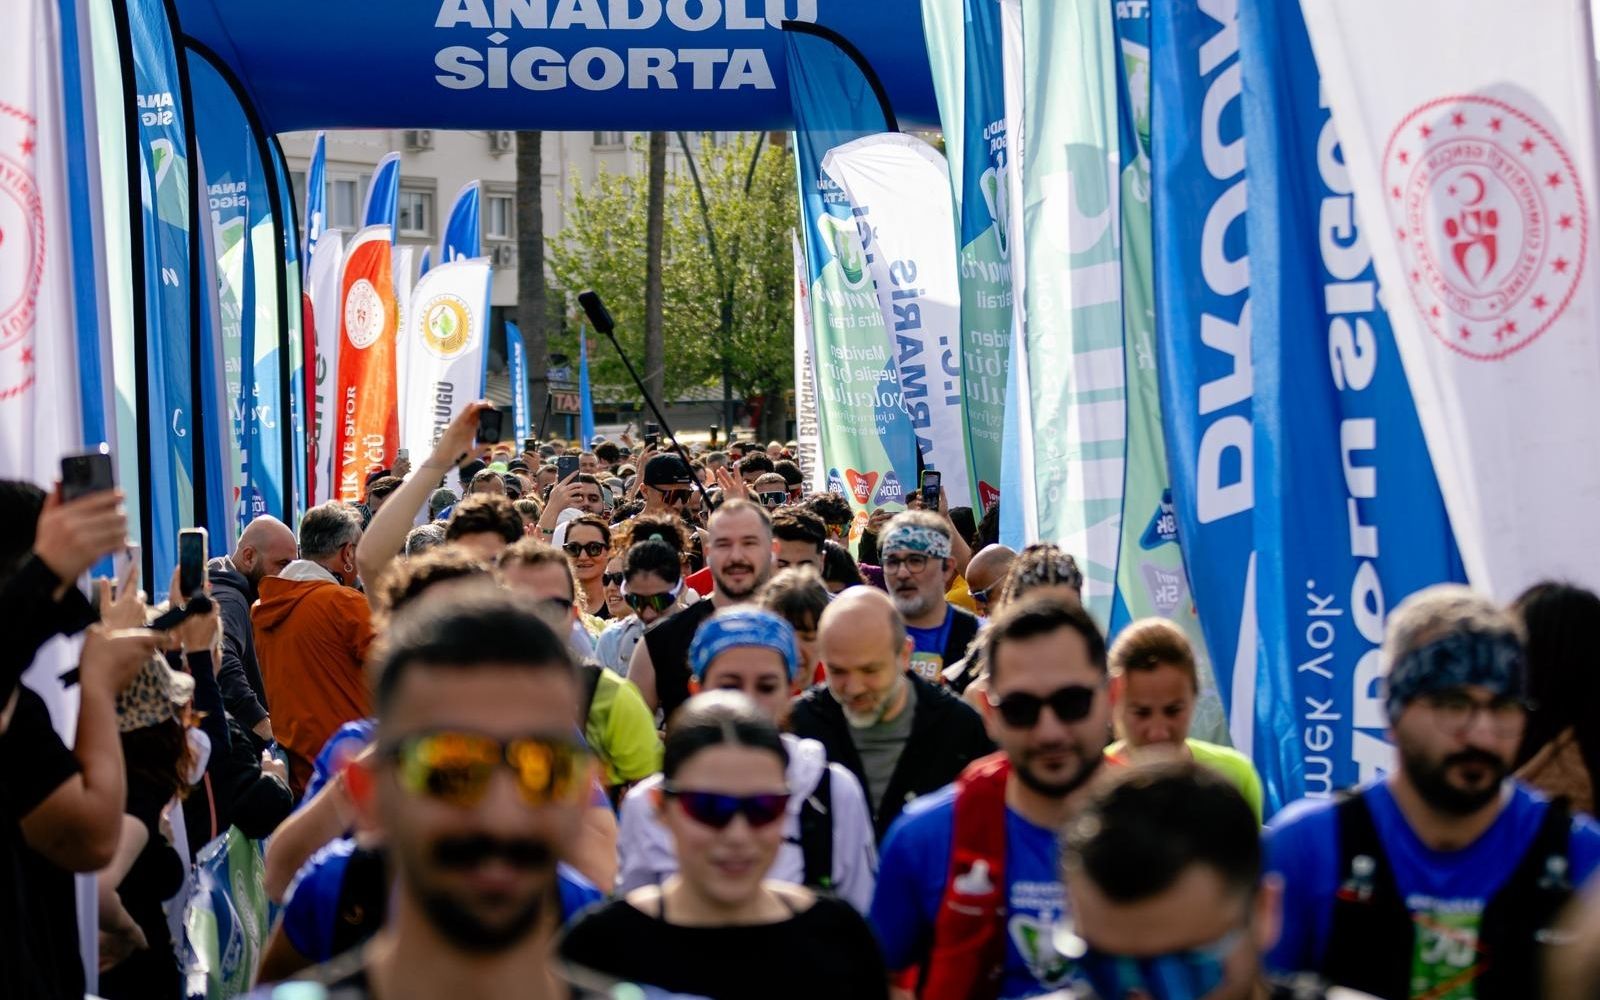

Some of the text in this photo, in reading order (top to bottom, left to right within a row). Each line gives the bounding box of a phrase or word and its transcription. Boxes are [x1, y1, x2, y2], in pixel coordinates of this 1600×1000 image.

[434, 0, 819, 31] ANADOLU
[434, 32, 777, 90] SİGORTA
[554, 394, 581, 411] TAX
[339, 385, 360, 503] LİK VE SPOR
[362, 433, 385, 474] ÜĞÜ
